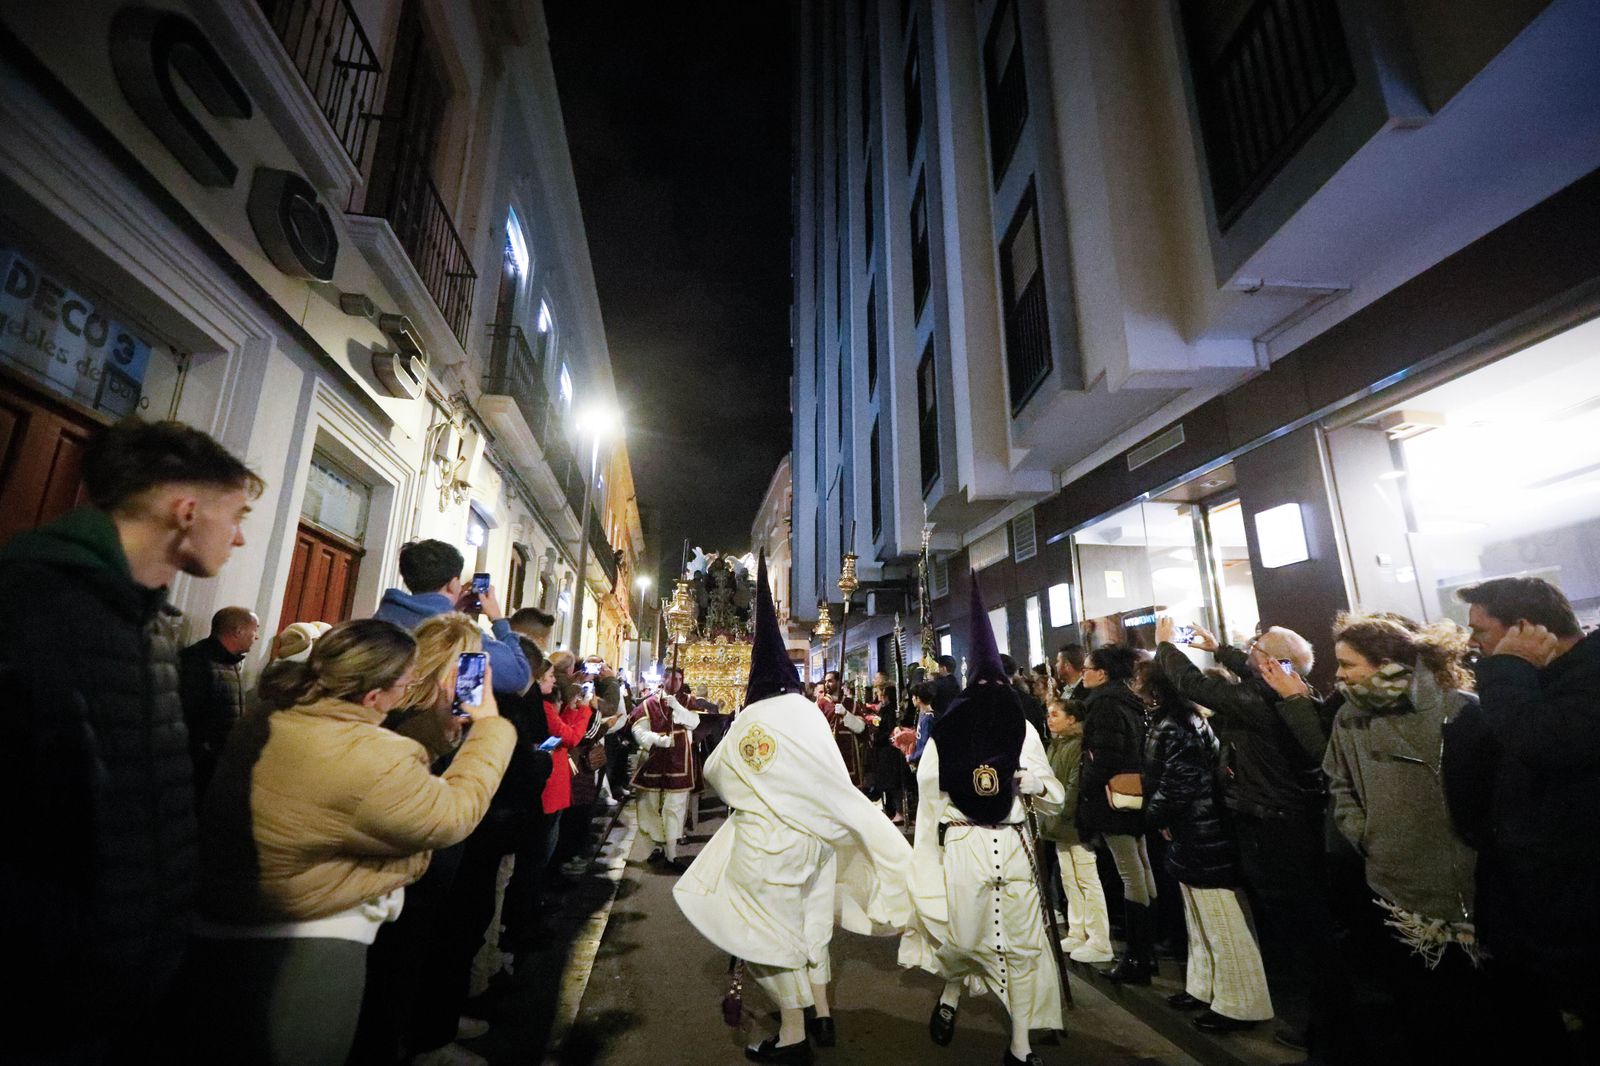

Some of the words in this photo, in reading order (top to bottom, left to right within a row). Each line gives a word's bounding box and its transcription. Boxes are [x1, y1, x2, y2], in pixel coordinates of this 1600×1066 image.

[4, 259, 110, 348] DECO
[112, 333, 136, 366] 3
[76, 356, 101, 381] de
